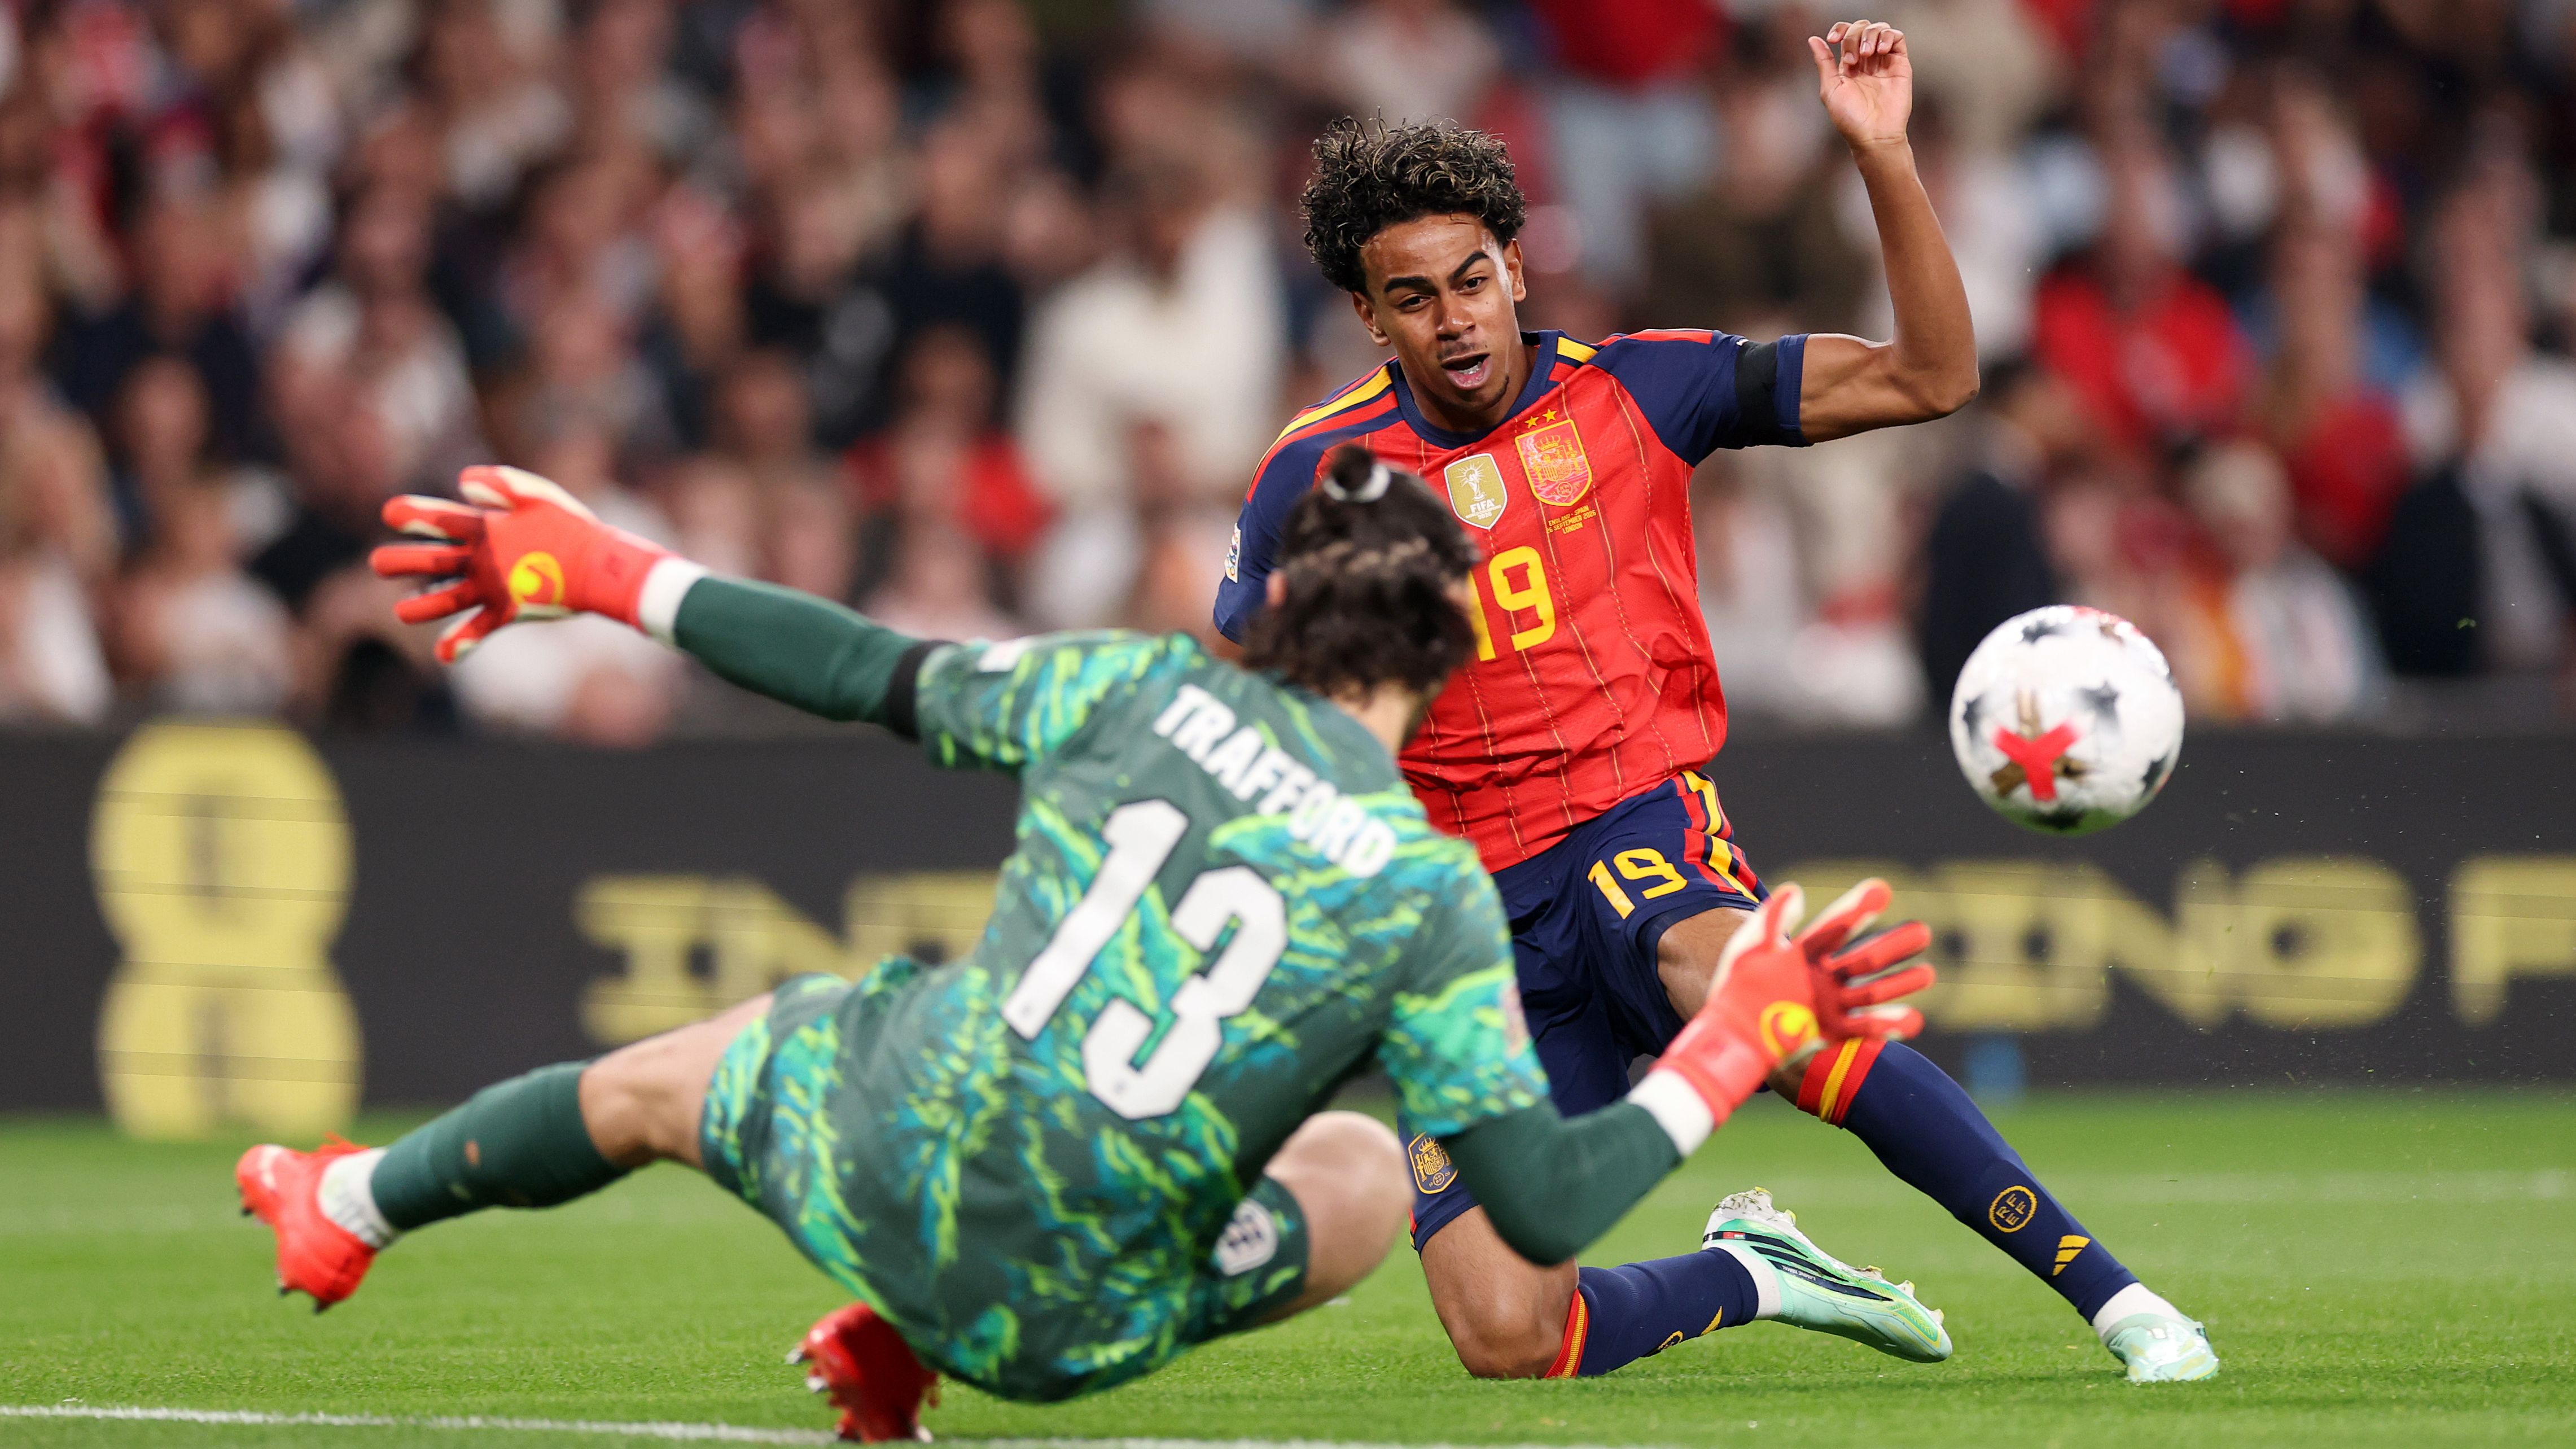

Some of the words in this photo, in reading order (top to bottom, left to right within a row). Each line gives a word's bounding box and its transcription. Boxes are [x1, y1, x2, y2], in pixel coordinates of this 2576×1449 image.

[1469, 499, 1495, 514] FIFA
[1548, 514, 1571, 527] ENGLAND
[1574, 505, 1589, 515] SPAIN
[1553, 515, 1583, 531] SEPTEMBER
[1583, 510, 1597, 519] 2026
[1562, 522, 1583, 534] LONDON
[1152, 682, 1397, 879] TRAFFORD
[1587, 847, 1688, 920] 19
[1001, 798, 1289, 1120] 13
